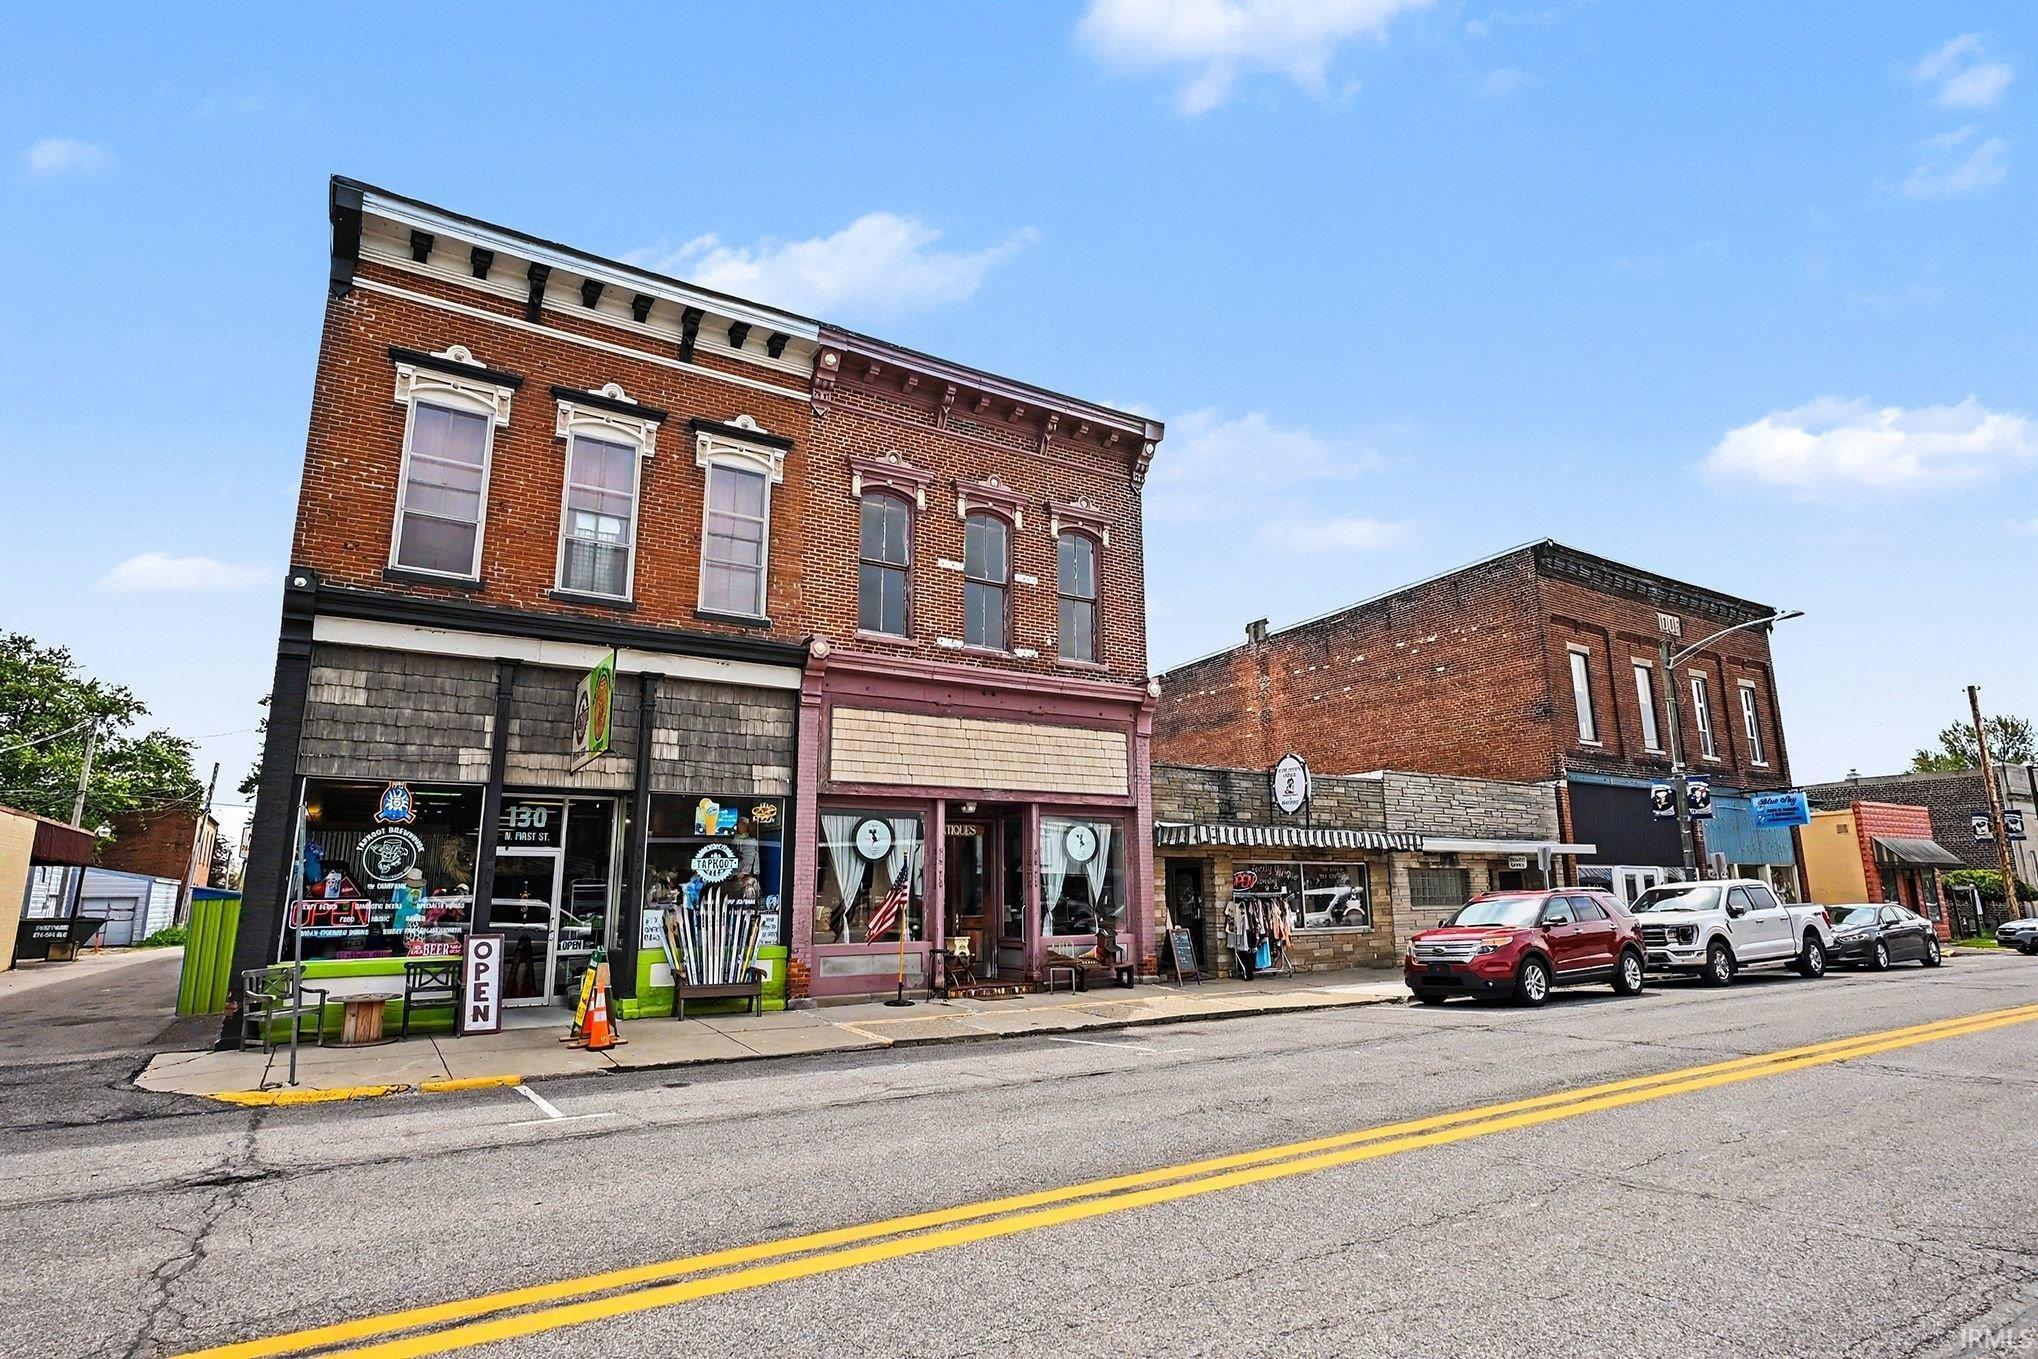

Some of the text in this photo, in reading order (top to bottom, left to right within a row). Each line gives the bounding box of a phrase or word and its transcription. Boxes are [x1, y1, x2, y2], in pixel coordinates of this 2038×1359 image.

[509, 806, 548, 828] 130
[515, 831, 537, 841] FIRST
[538, 832, 551, 842] ST.
[291, 902, 369, 926] OPEN
[423, 943, 450, 956] BEER
[561, 941, 583, 951] OPEN
[472, 941, 493, 1022] OPEN
